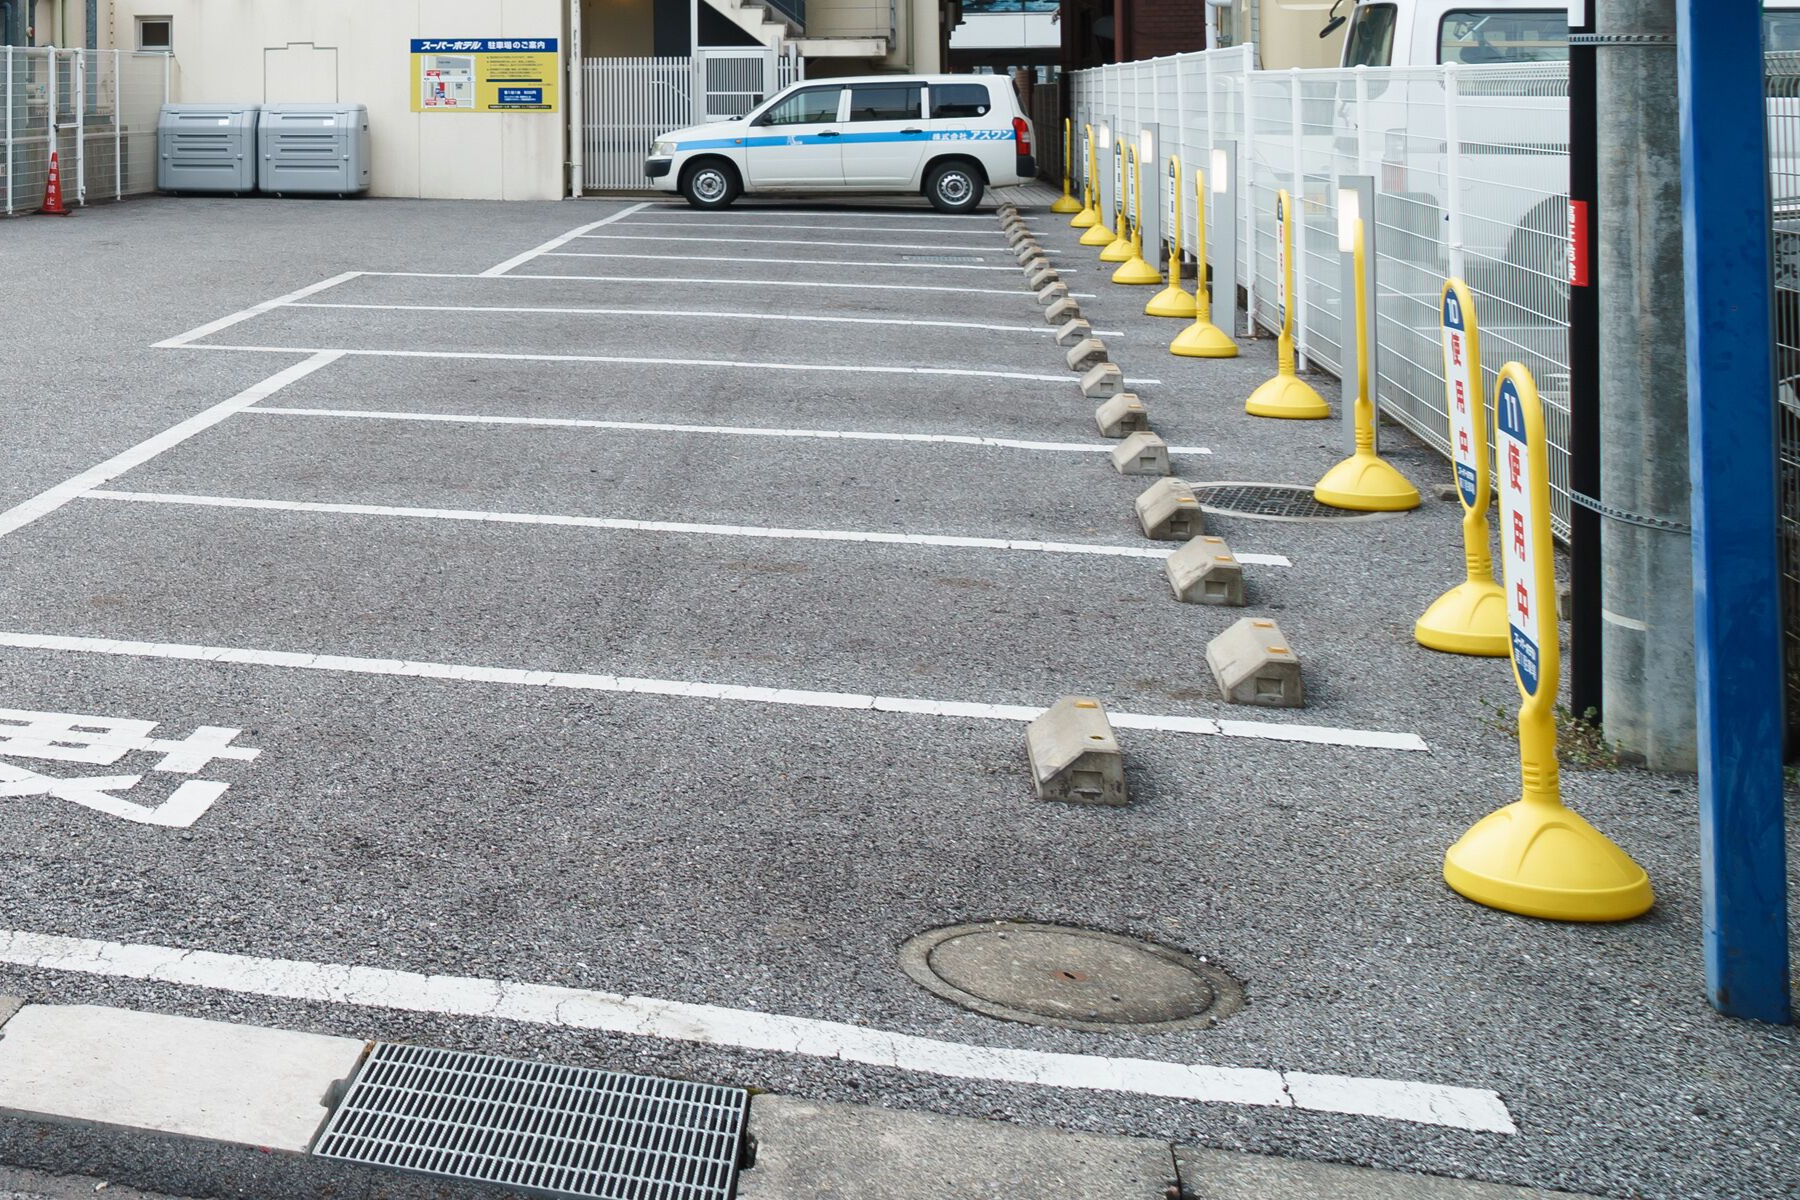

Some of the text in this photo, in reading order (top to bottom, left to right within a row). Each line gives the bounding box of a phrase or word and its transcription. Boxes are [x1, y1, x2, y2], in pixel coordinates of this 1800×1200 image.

[421, 41, 545, 50] スーパーホテル 駐車場のご案内
[970, 130, 1012, 140] アスワン
[1446, 298, 1459, 325] 10
[1451, 331, 1469, 460] 使用中
[1503, 392, 1520, 433] 11
[1508, 440, 1530, 627] 使用中
